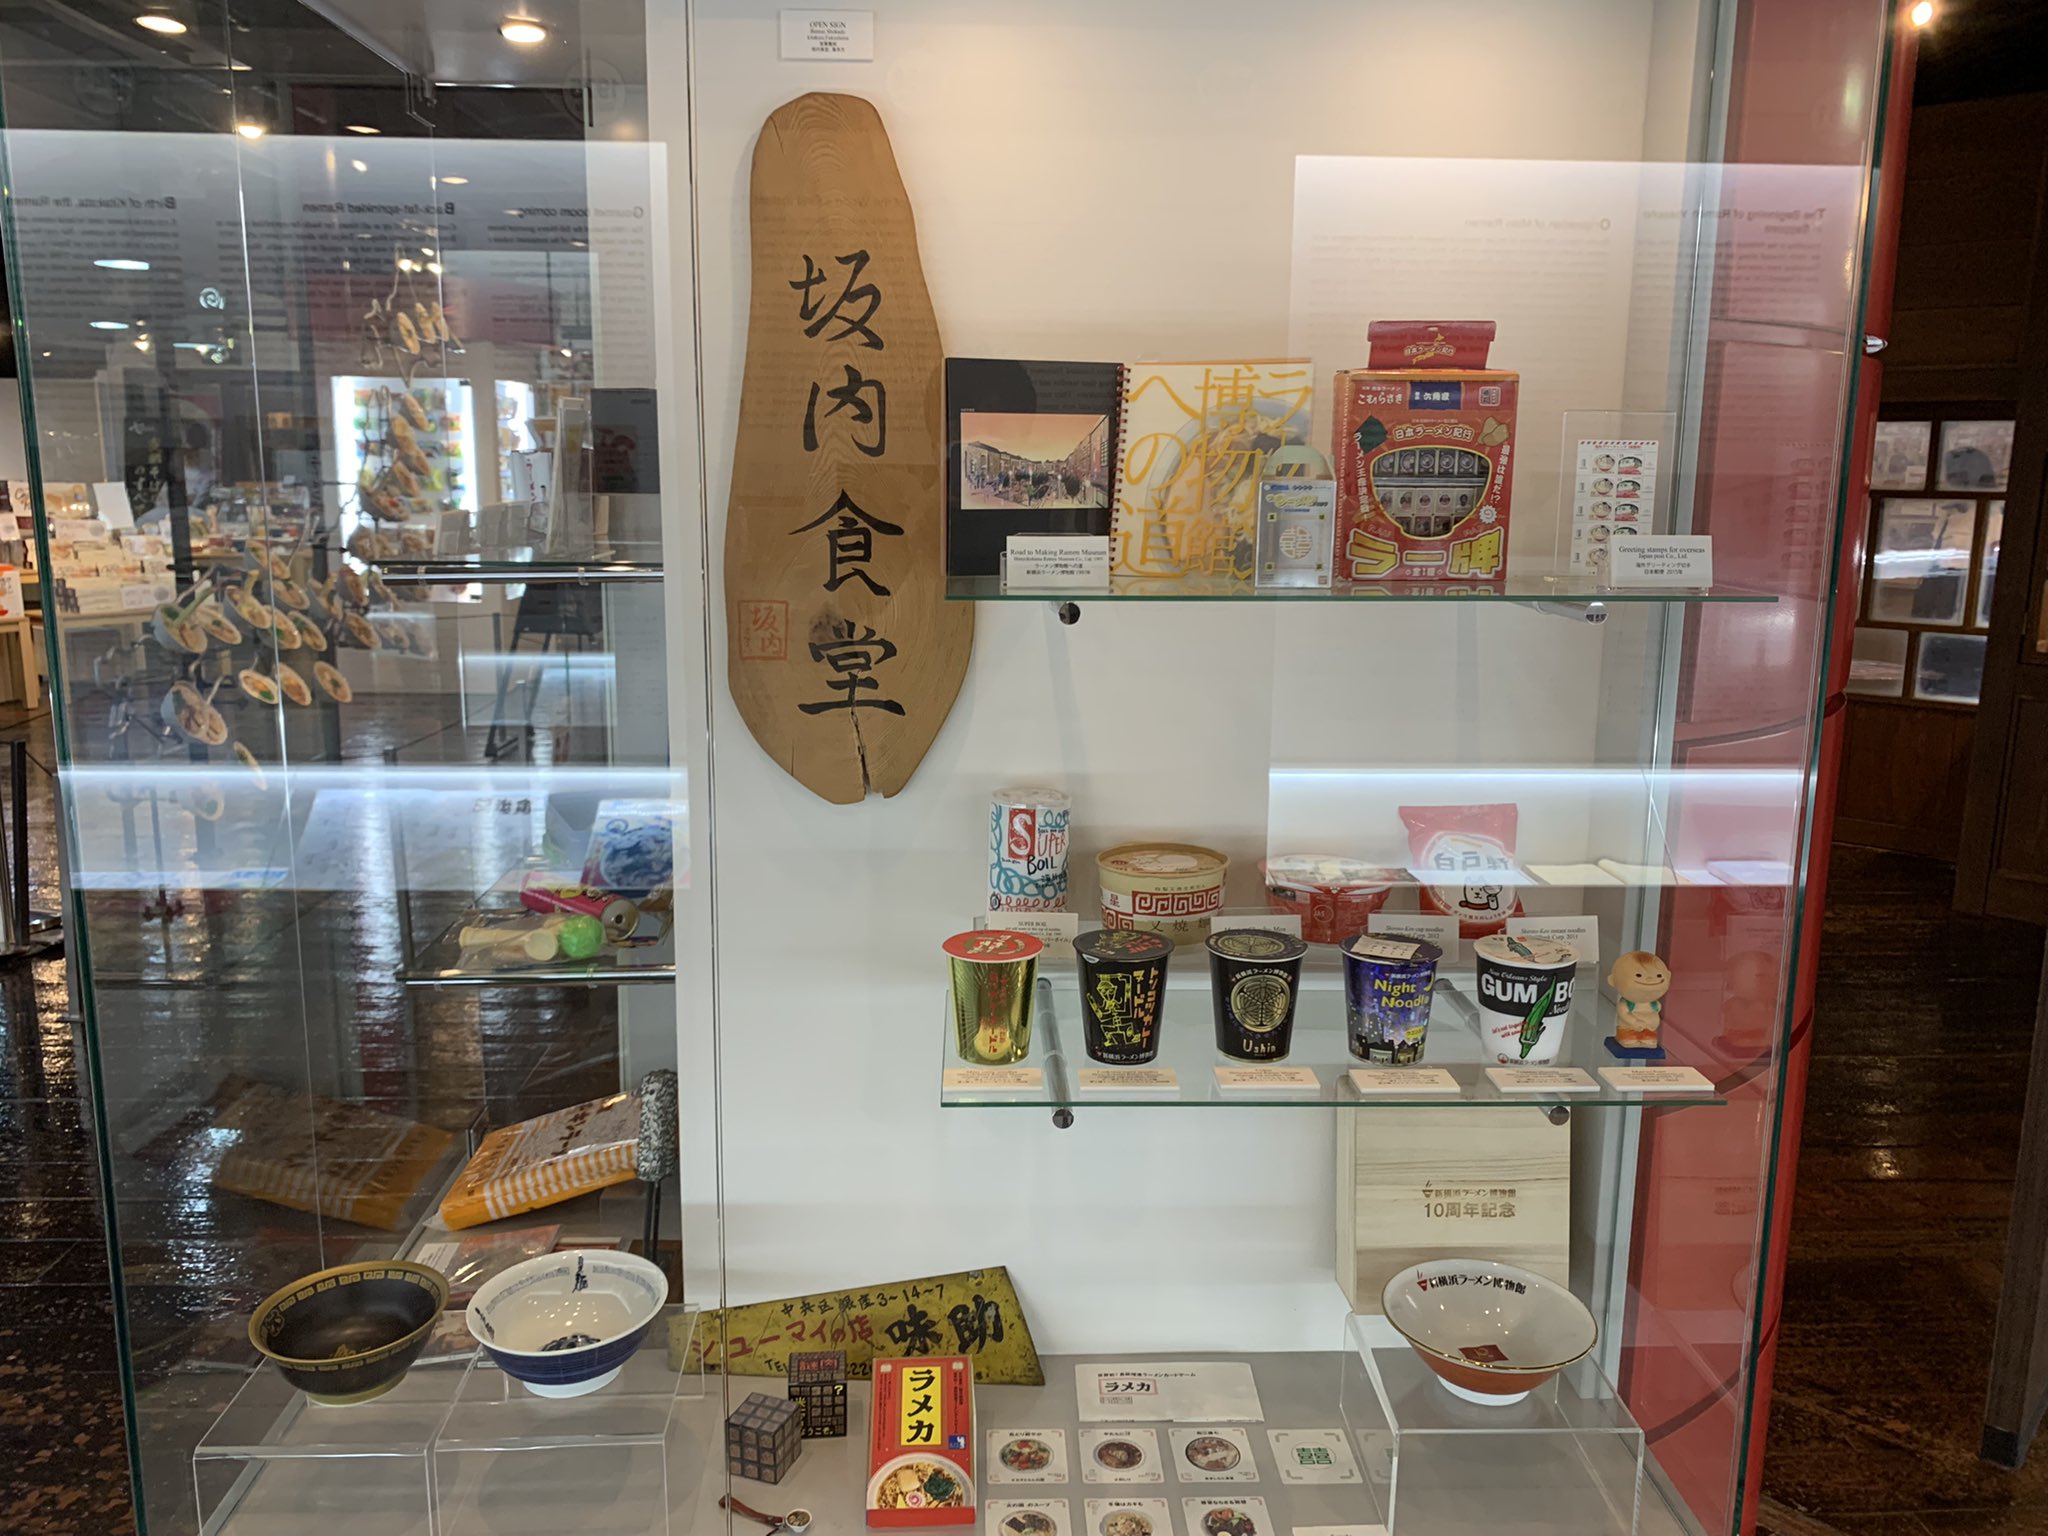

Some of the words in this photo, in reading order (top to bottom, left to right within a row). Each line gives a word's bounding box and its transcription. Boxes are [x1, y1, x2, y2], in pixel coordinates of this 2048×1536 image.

[1358, 392, 1403, 405] こむらさき
[1394, 426, 1473, 440] 日本ラーメン紀行
[788, 249, 906, 716] 坂内食堂
[1035, 549, 1057, 557] Making
[1027, 855, 1057, 875] BOIL
[1133, 970, 1145, 1018] ヌードル
[1374, 979, 1416, 996] Night
[1141, 967, 1159, 1048] トンコツカレー
[1434, 1188, 1517, 1198] 新横浜ラーメン博物館
[1424, 1202, 1516, 1218] 10周年記念
[1105, 1382, 1151, 1392] ラメカ
[906, 1368, 936, 1443] ラメカ
